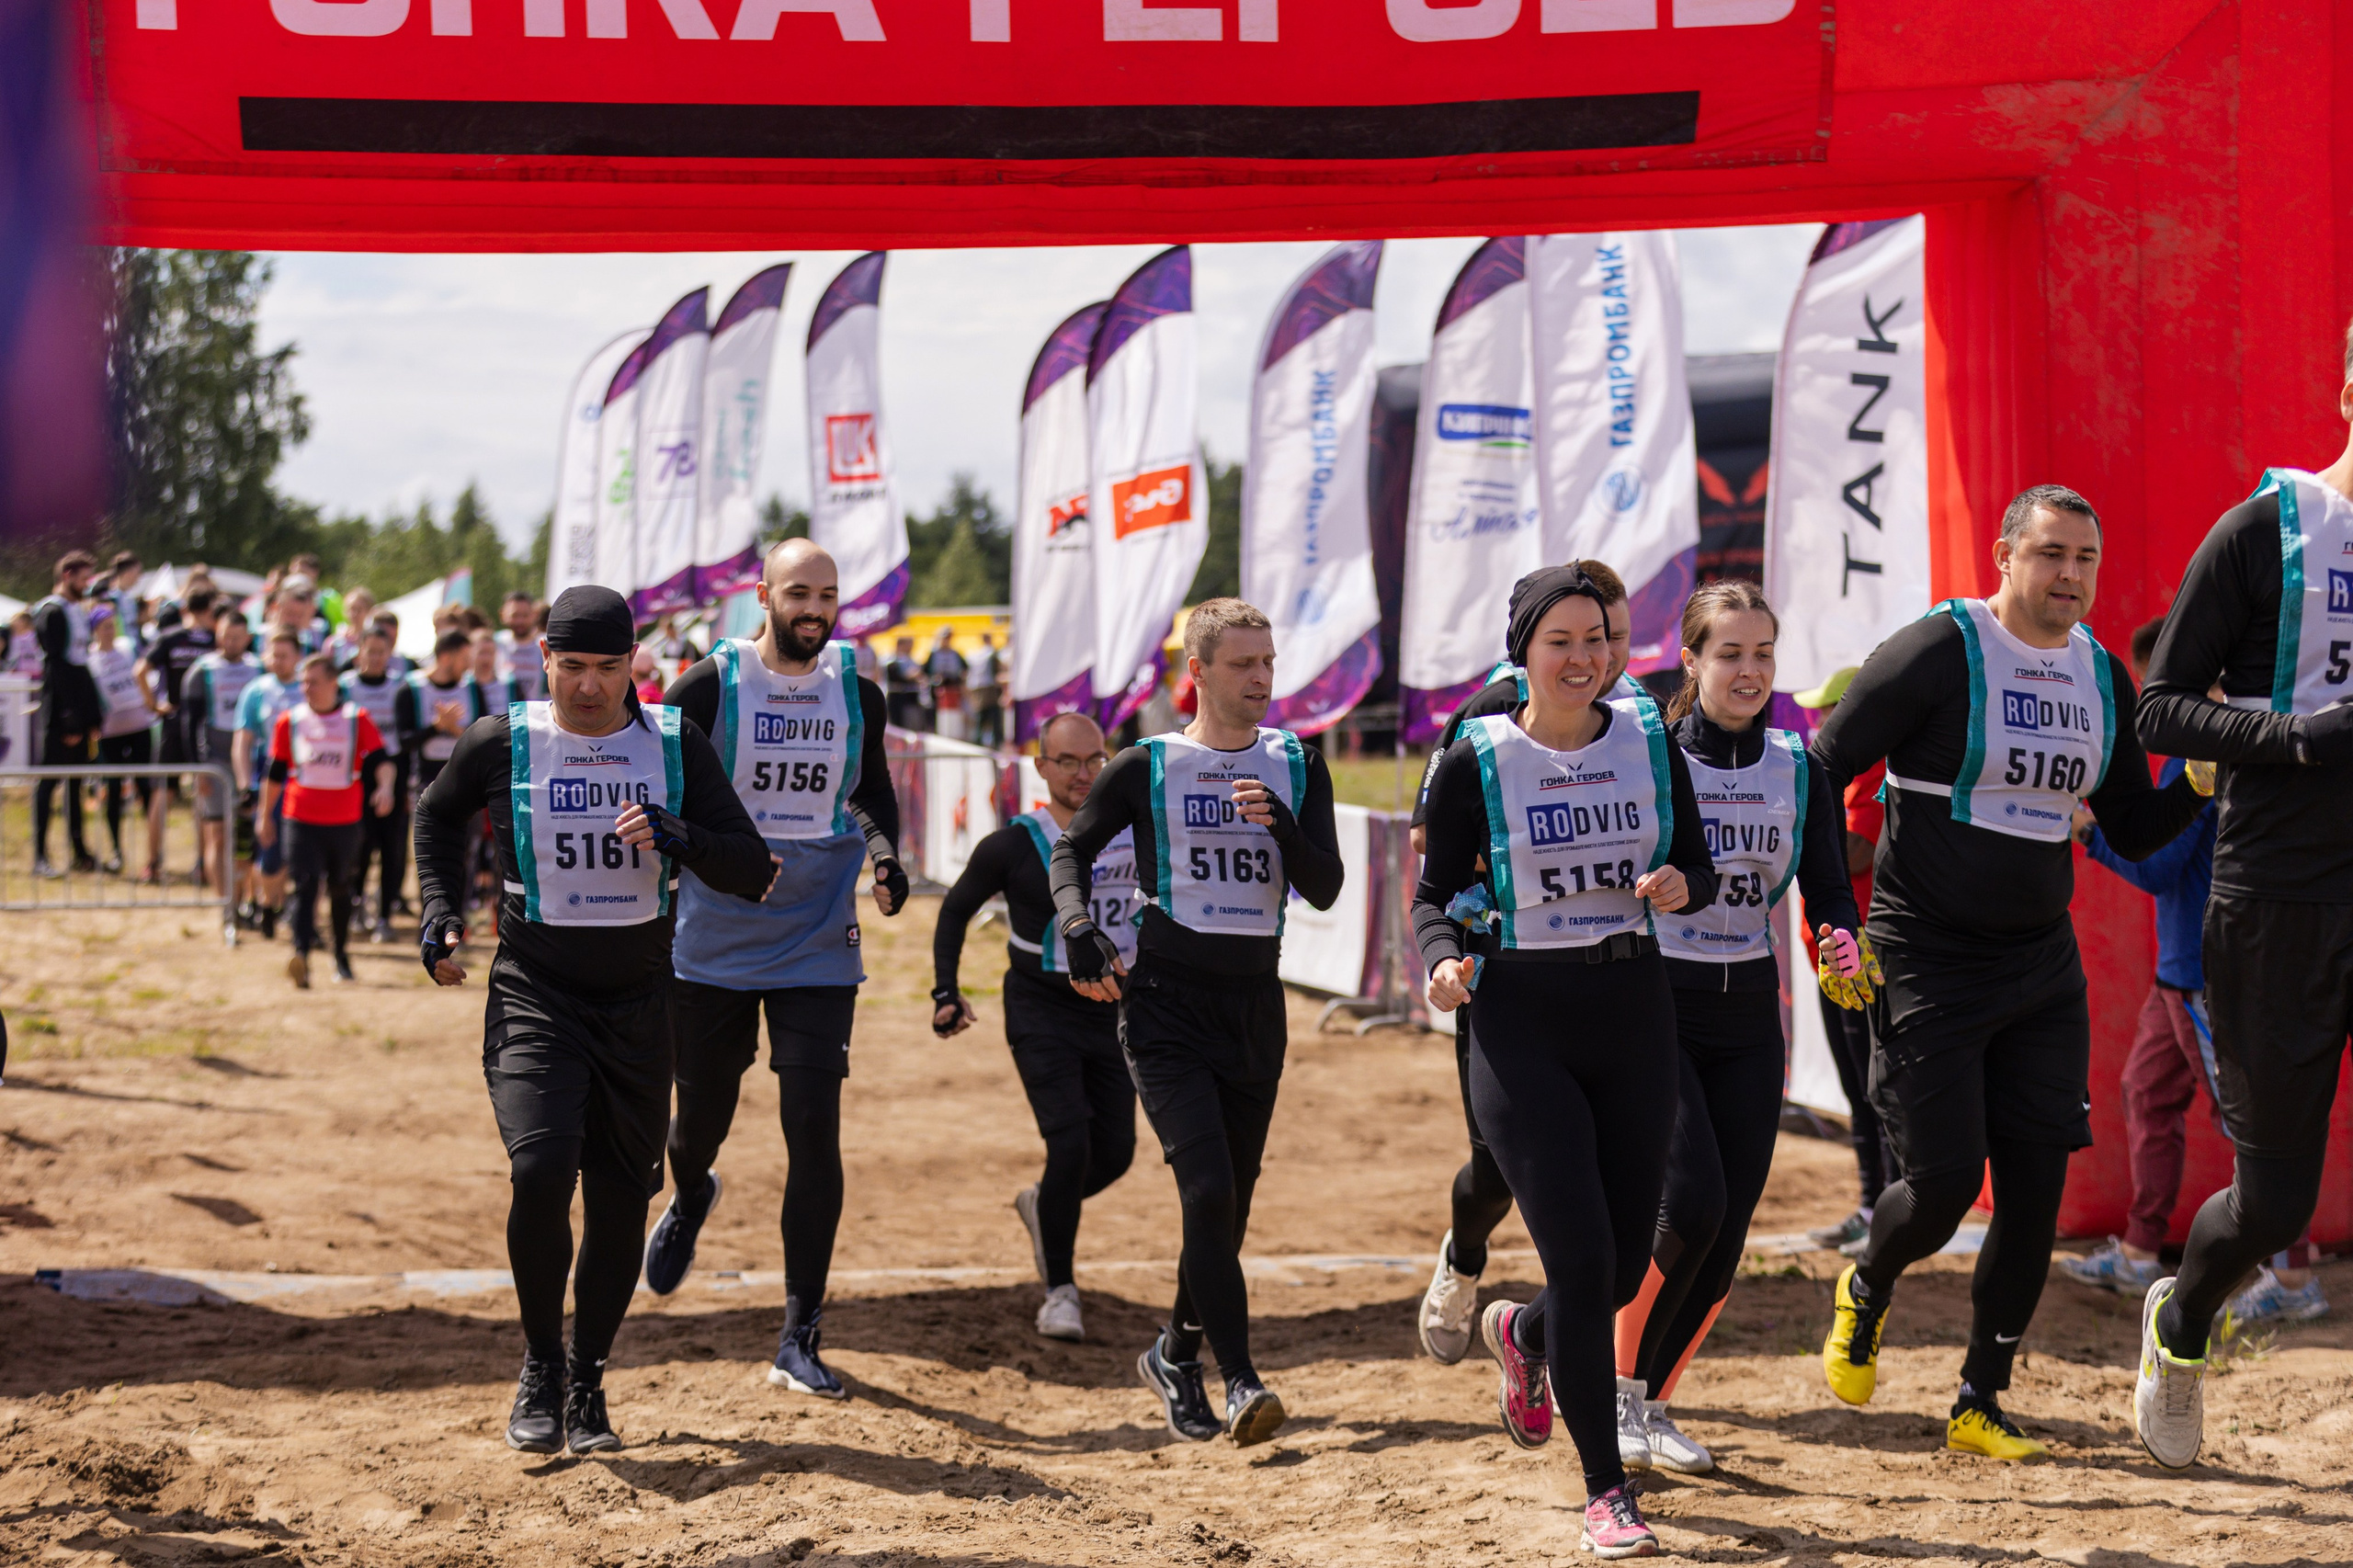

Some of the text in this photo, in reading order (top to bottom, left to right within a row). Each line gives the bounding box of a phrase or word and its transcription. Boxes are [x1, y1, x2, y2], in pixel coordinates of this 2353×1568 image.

[1596, 243, 1636, 448] ГАЗПРОМБАНК
[1841, 292, 1904, 597] TANK
[2015, 667, 2074, 683] ГОНКА ГЕРОЕВ
[2006, 696, 2090, 733] RODVIG
[757, 717, 835, 741] RODVIG
[597, 755, 630, 763] ГЕРОЕВ
[2004, 747, 2086, 793] 5160
[752, 761, 829, 793] 5156
[1540, 770, 1615, 787] ГОНКА ГЕРОЕВ
[553, 782, 649, 807] RODVIG
[1696, 792, 1727, 801] ГОНКА
[770, 813, 814, 822] ГАЗПРОМБАНК
[1531, 801, 1641, 840] RODVIG
[2021, 807, 2063, 822] ГАЗПРОМБАНК
[1703, 824, 1779, 853] ODVIG
[1189, 846, 1270, 884] 5163
[1540, 858, 1635, 903] 5158
[1712, 871, 1764, 907] 59
[585, 894, 638, 903] ГАЗПРОМБАНК
[1219, 905, 1264, 916] ГАЗПРОМБАНК
[1569, 915, 1624, 926] ГАЗПРОМБАНК
